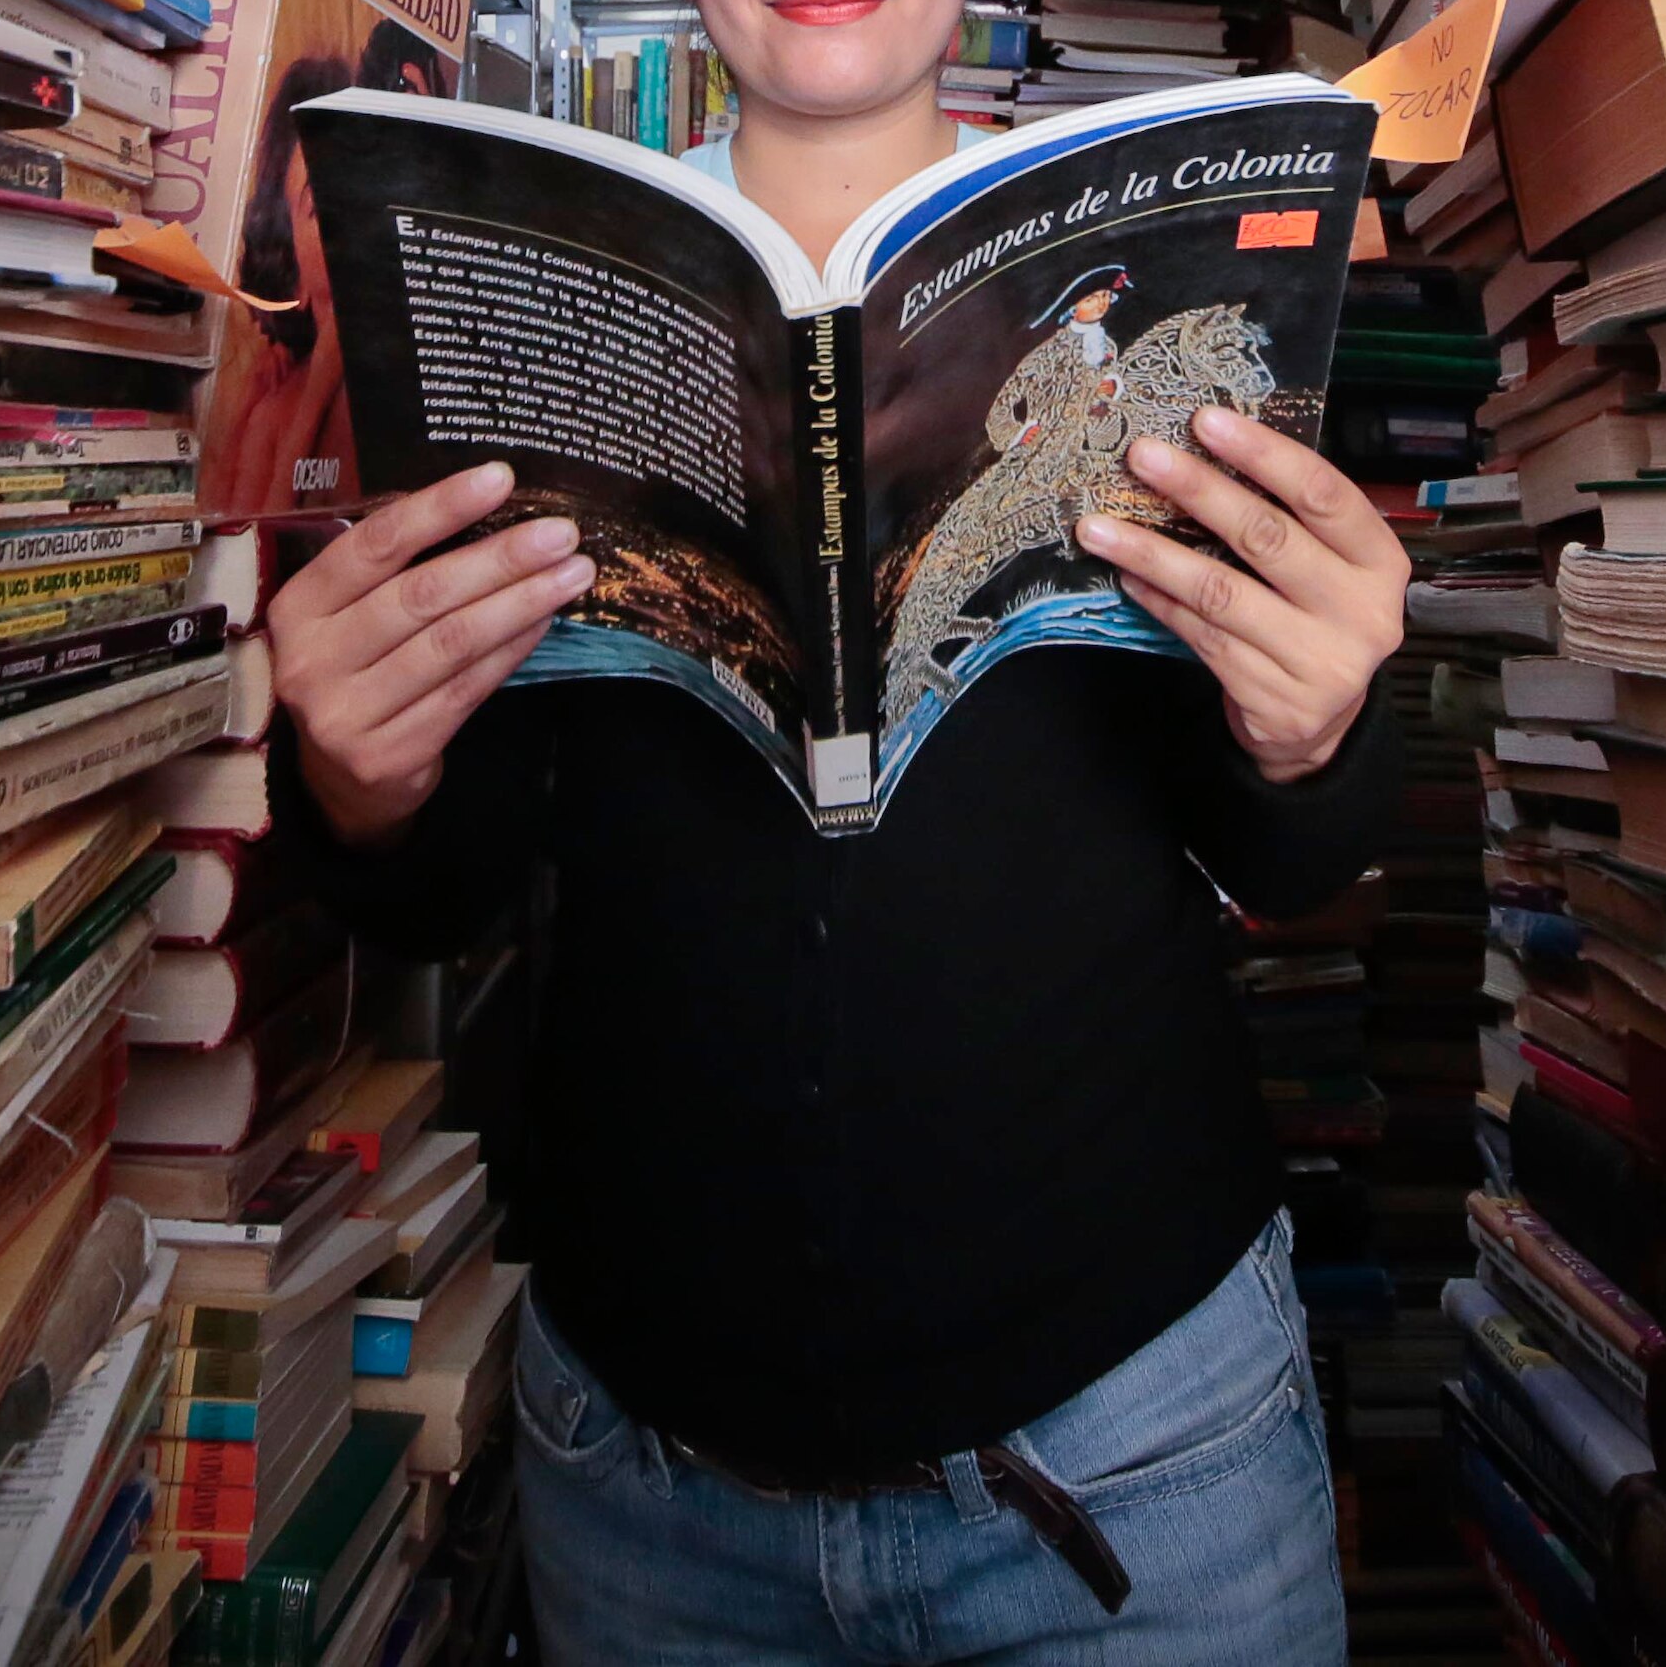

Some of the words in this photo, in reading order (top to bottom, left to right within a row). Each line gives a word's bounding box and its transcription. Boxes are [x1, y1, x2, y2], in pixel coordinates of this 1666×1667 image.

[1431, 24, 1455, 68] NO
[1381, 67, 1472, 120] TOCAR
[431, 228, 499, 255] Estampas
[504, 238, 521, 256] de
[526, 245, 538, 259] la
[542, 252, 593, 276] Colonia
[897, 208, 1056, 333] Estampas
[1063, 186, 1108, 227] de
[1119, 170, 1159, 208] la
[1172, 142, 1336, 192] Colonia
[426, 246, 538, 276] acontecimientos
[541, 270, 598, 293] sonados
[469, 270, 532, 292] aparecen
[409, 295, 489, 316] minuciosos
[431, 279, 474, 297] textos
[477, 287, 546, 313] novelados
[480, 336, 512, 353] Ante
[805, 314, 836, 402] Colonia
[496, 402, 537, 419] Todos
[811, 407, 837, 428] la
[812, 435, 838, 459] de
[292, 456, 340, 491] OCEANO
[817, 465, 847, 555] Estampas
[16, 532, 87, 558] POTENCIAR
[89, 528, 124, 550] COMO
